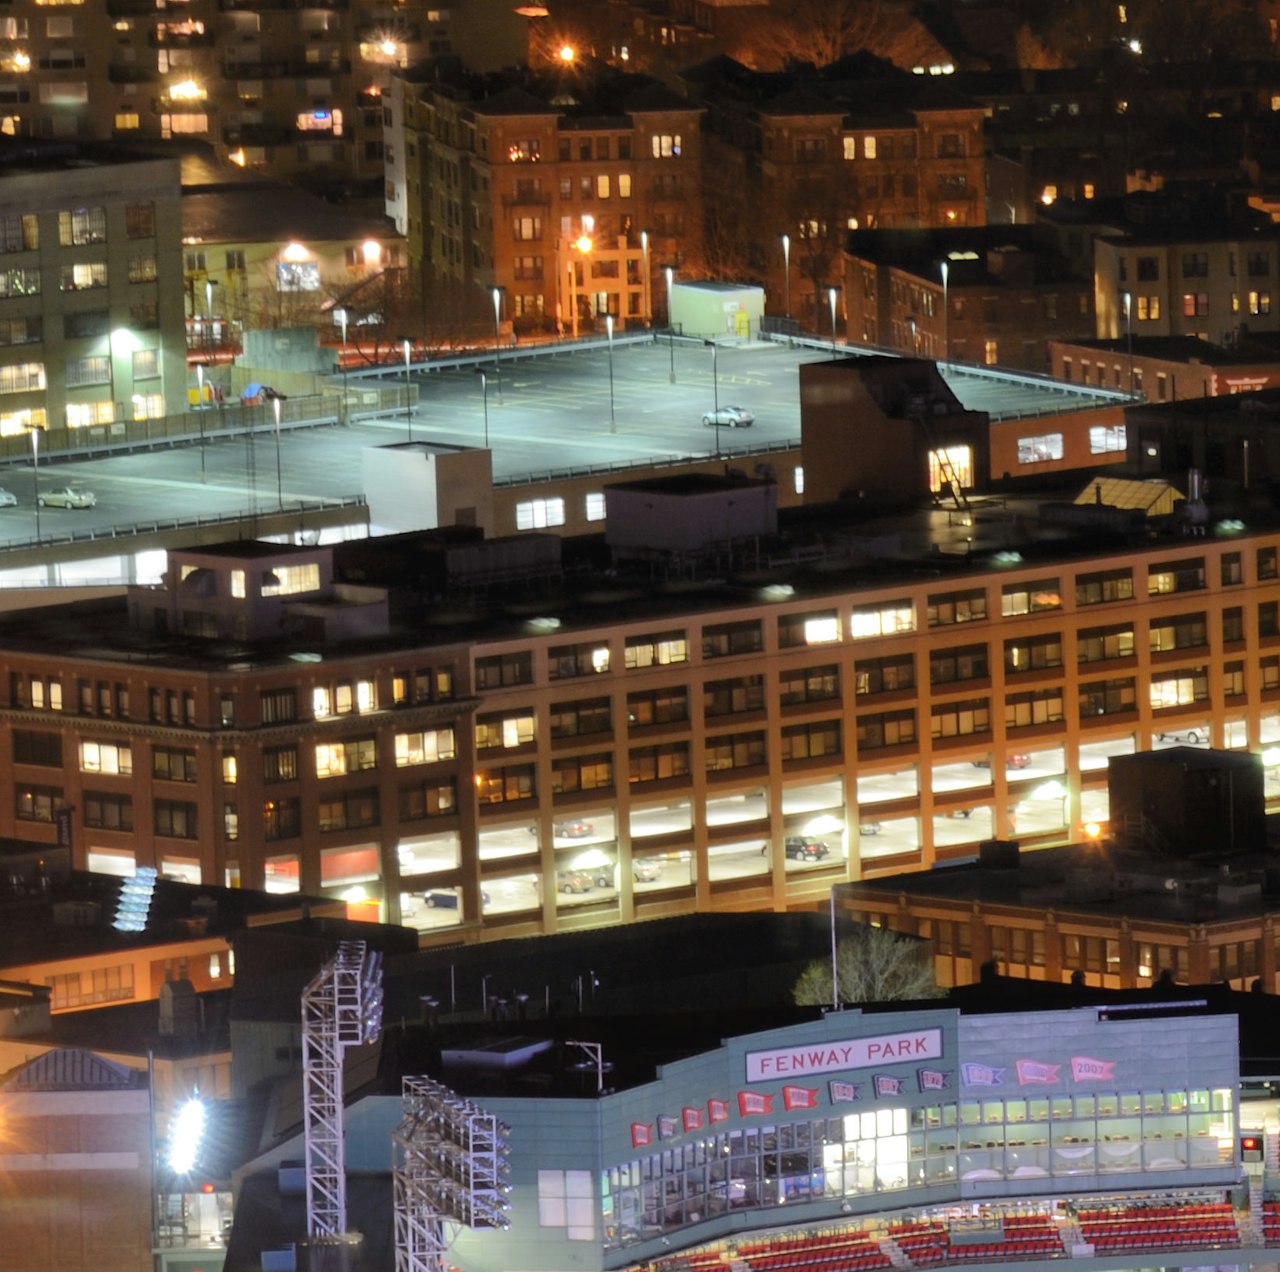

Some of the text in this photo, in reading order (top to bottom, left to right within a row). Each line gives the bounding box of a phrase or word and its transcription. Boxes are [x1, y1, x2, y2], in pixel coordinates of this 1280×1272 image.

[760, 1037, 929, 1074] FENWAY PARK
[1077, 1063, 1104, 1074] 2007
